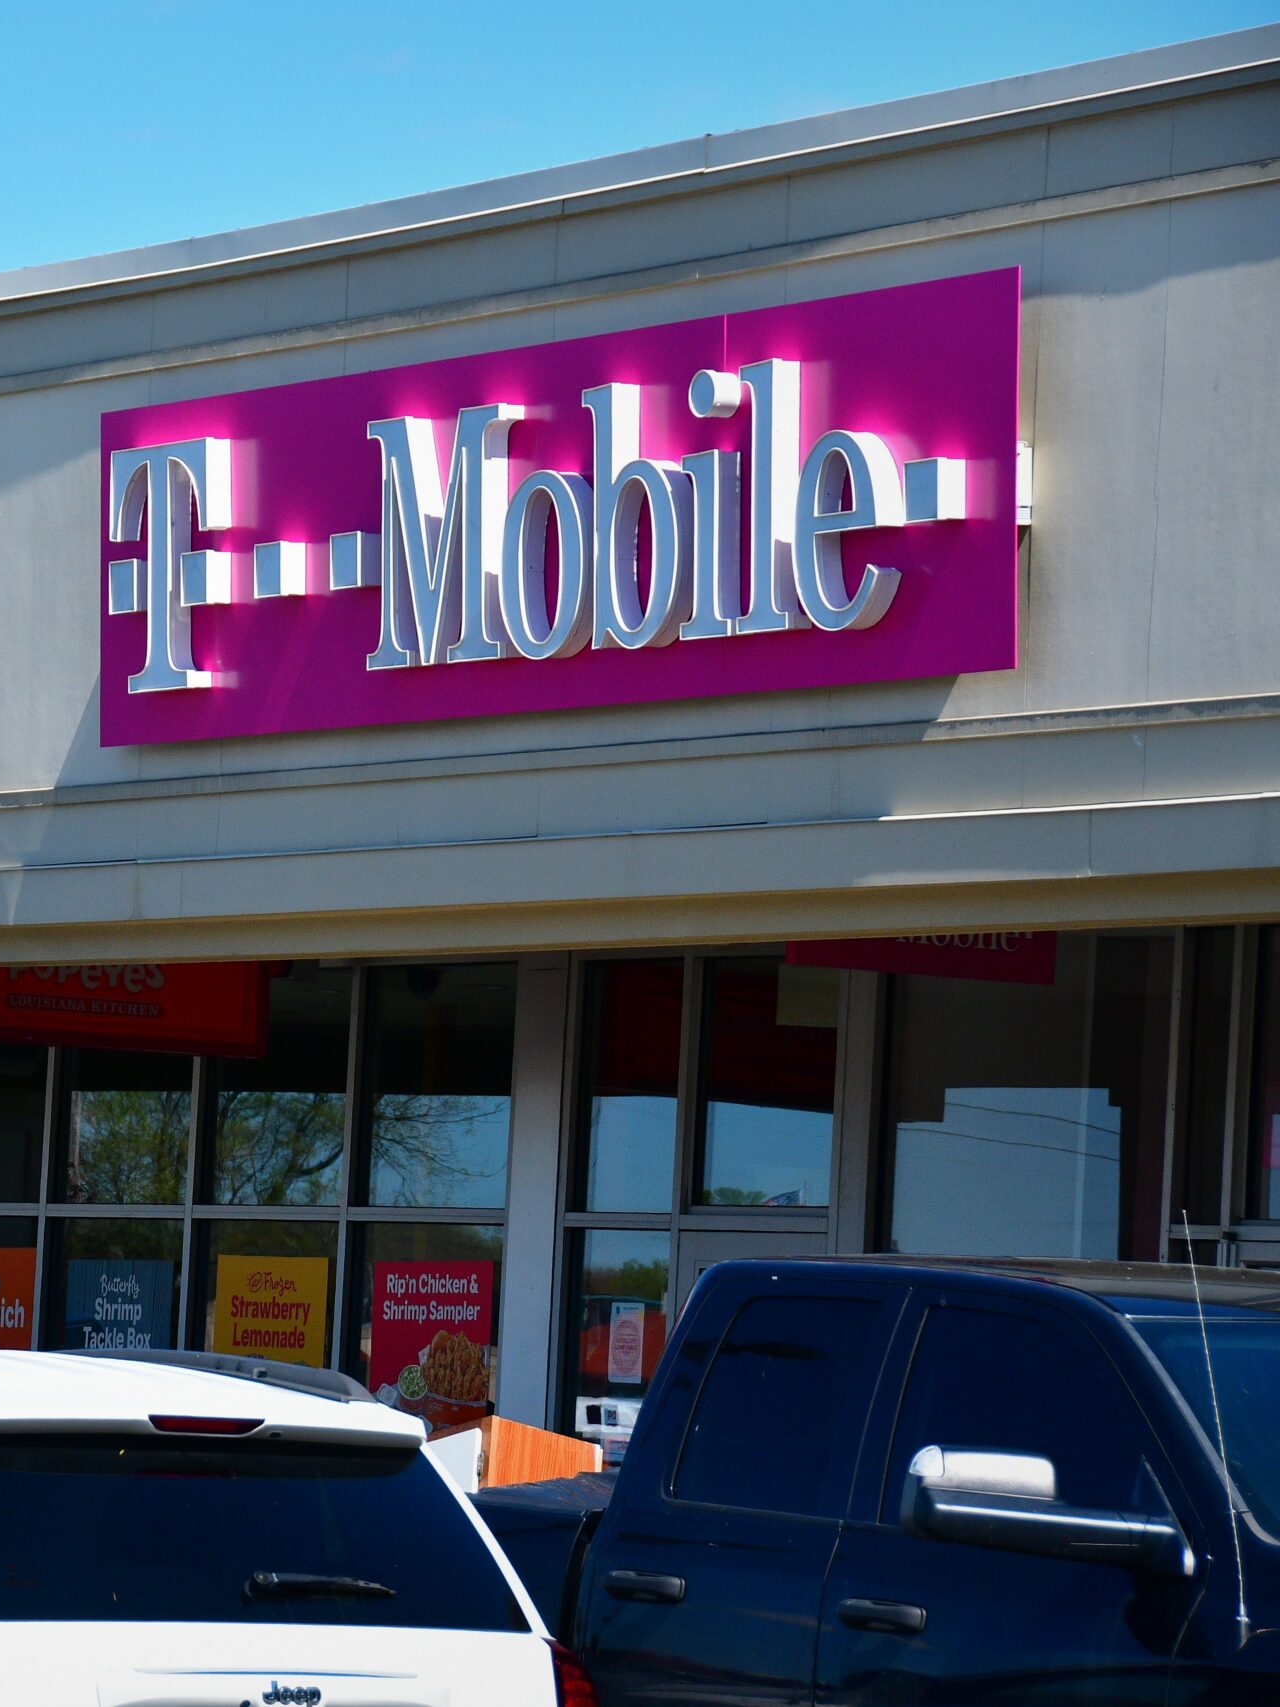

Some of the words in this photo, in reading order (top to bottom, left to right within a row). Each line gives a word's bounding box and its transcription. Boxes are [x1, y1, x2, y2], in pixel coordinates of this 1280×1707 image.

[9, 994, 86, 1012] LOUISIANA
[91, 1000, 160, 1017] KITCHEN
[100, 1274, 140, 1299] Butterfly
[262, 1271, 297, 1296] Frozen
[386, 1273, 417, 1298] Rip'n
[419, 1273, 468, 1294] Chicken
[469, 1273, 479, 1294] &
[94, 1297, 143, 1325] Shrimp
[230, 1294, 311, 1326] Strawberry
[382, 1300, 427, 1325] Shrimp
[429, 1300, 480, 1325] Sampler
[83, 1326, 125, 1350] Tackle
[126, 1326, 152, 1350] Box
[232, 1323, 305, 1349] Lemonade
[262, 1680, 322, 1707] Jeep
